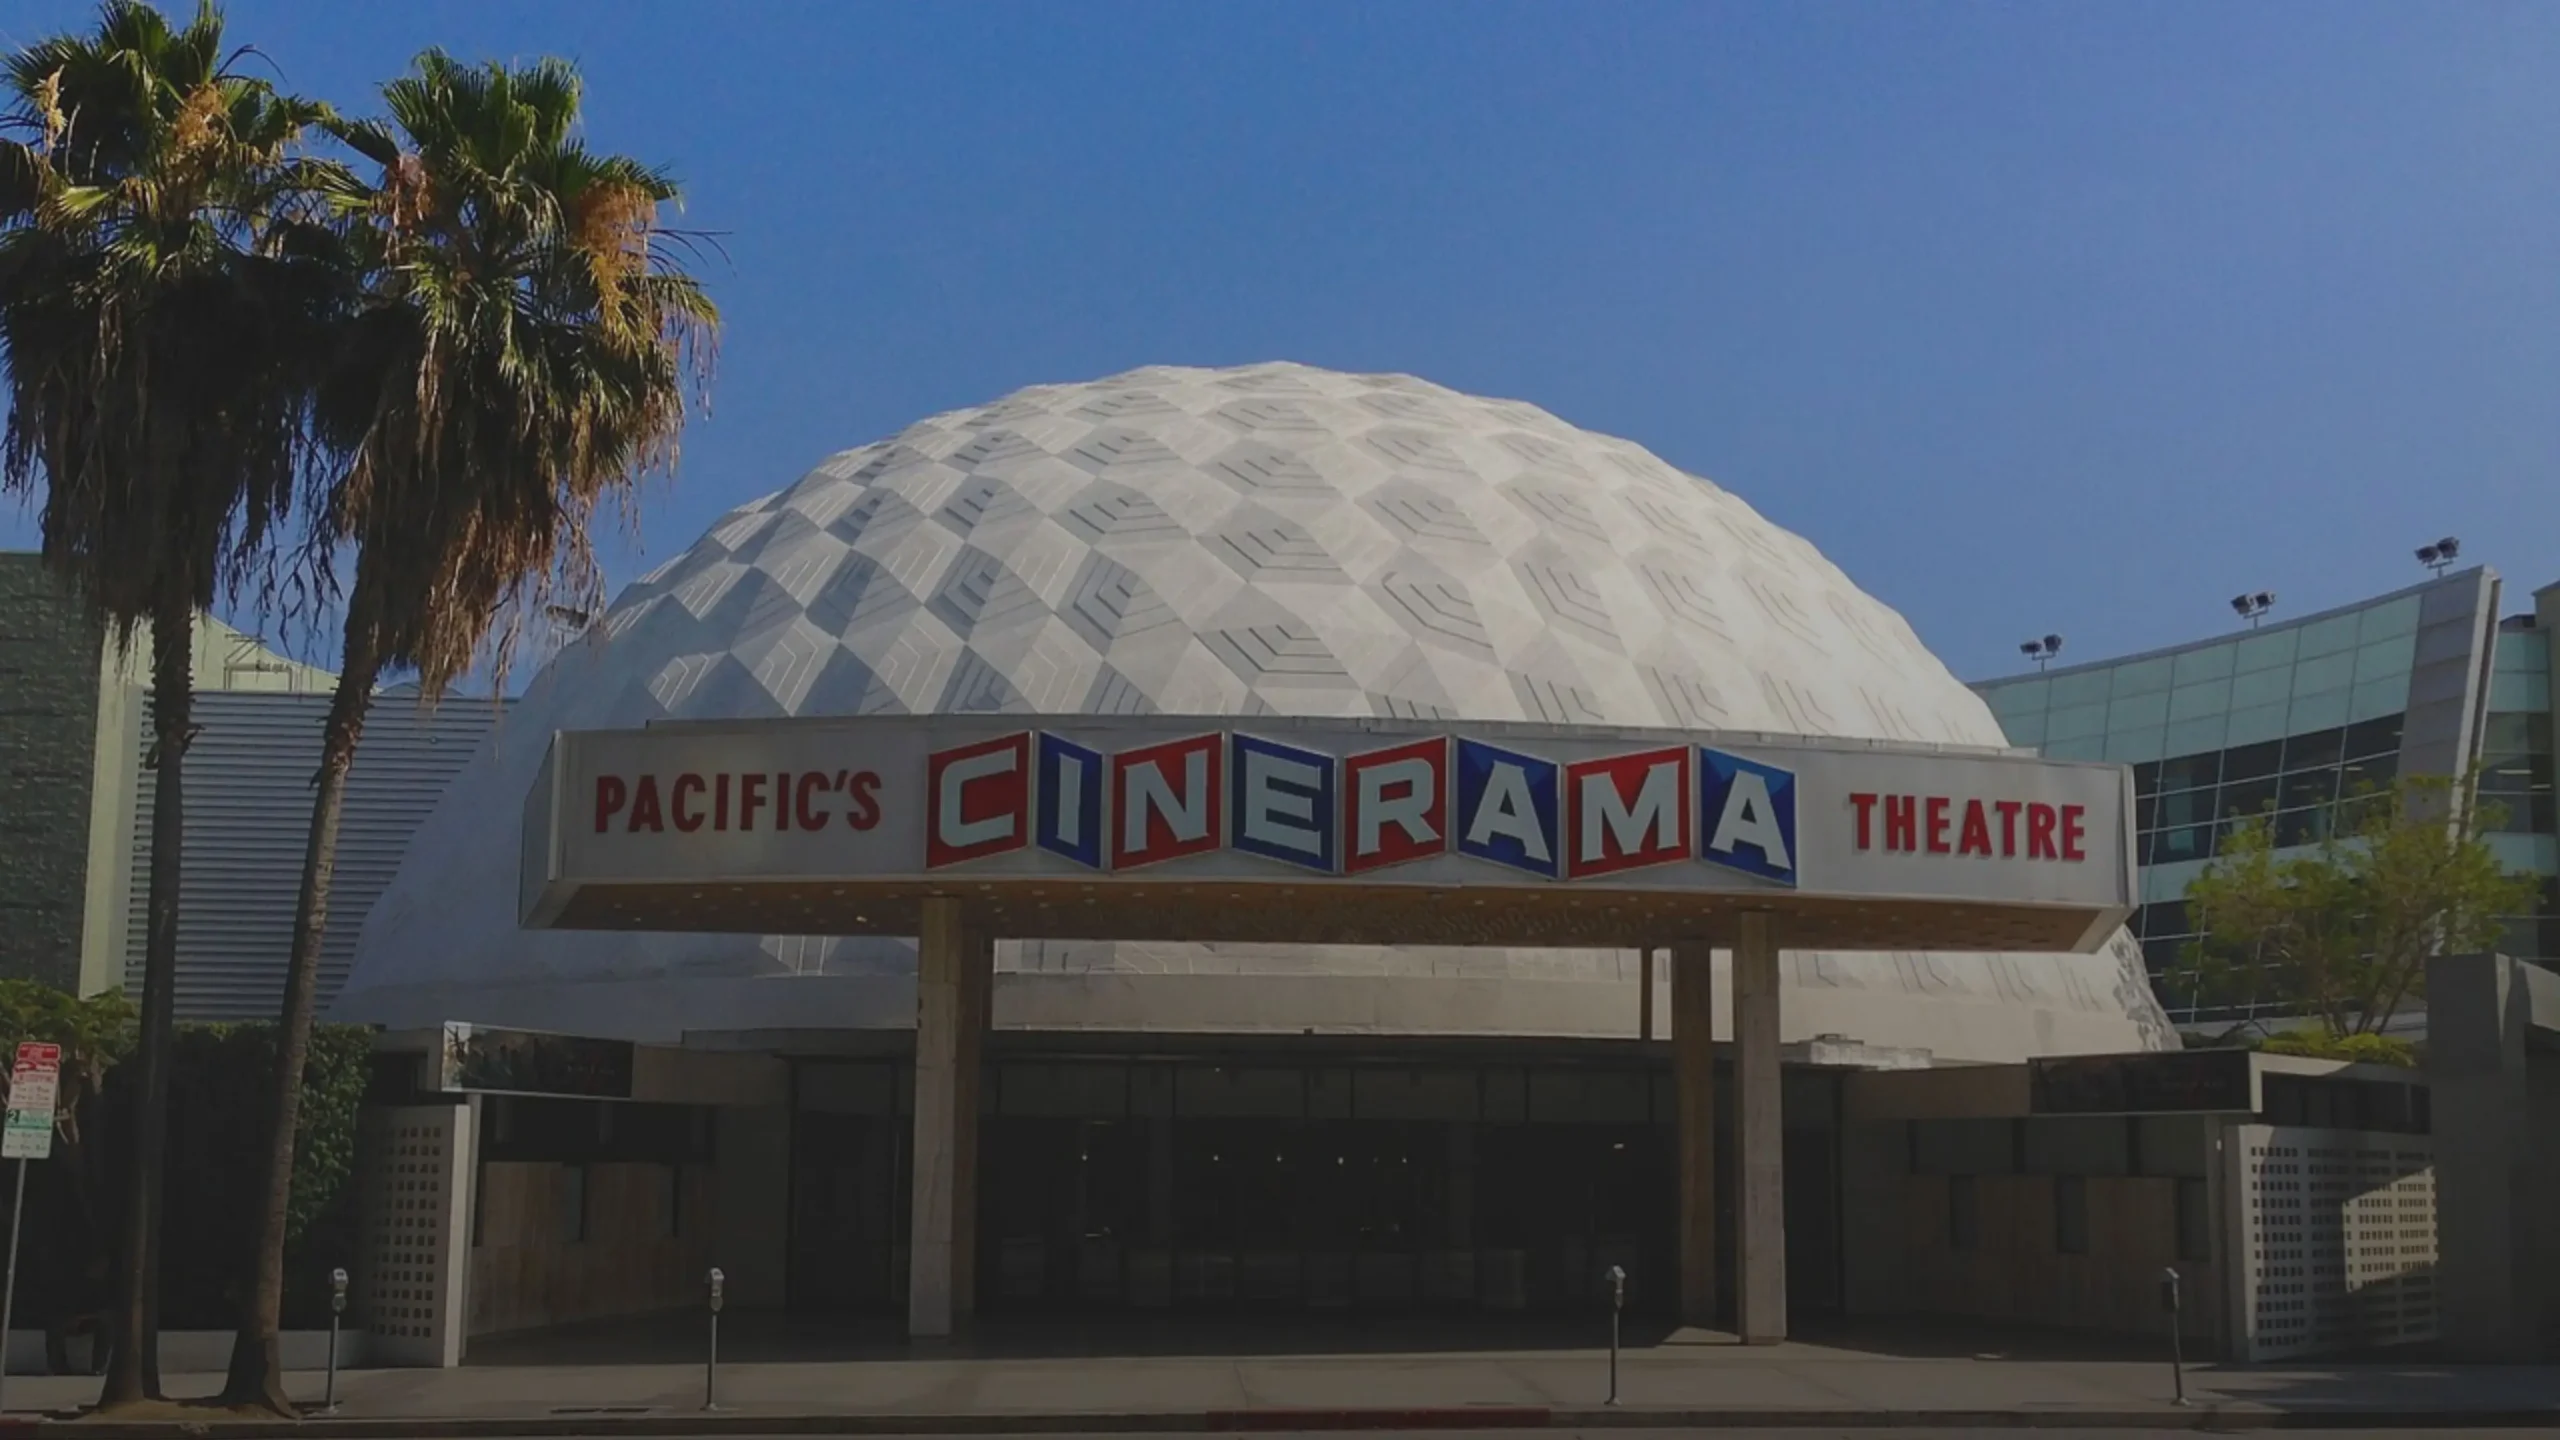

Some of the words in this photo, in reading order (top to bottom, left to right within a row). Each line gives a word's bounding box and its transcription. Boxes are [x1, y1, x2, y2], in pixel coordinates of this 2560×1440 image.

[594, 769, 881, 833] PACIFIC'S
[938, 746, 1793, 872] CINERAMA
[1849, 793, 2087, 861] THEATRE
